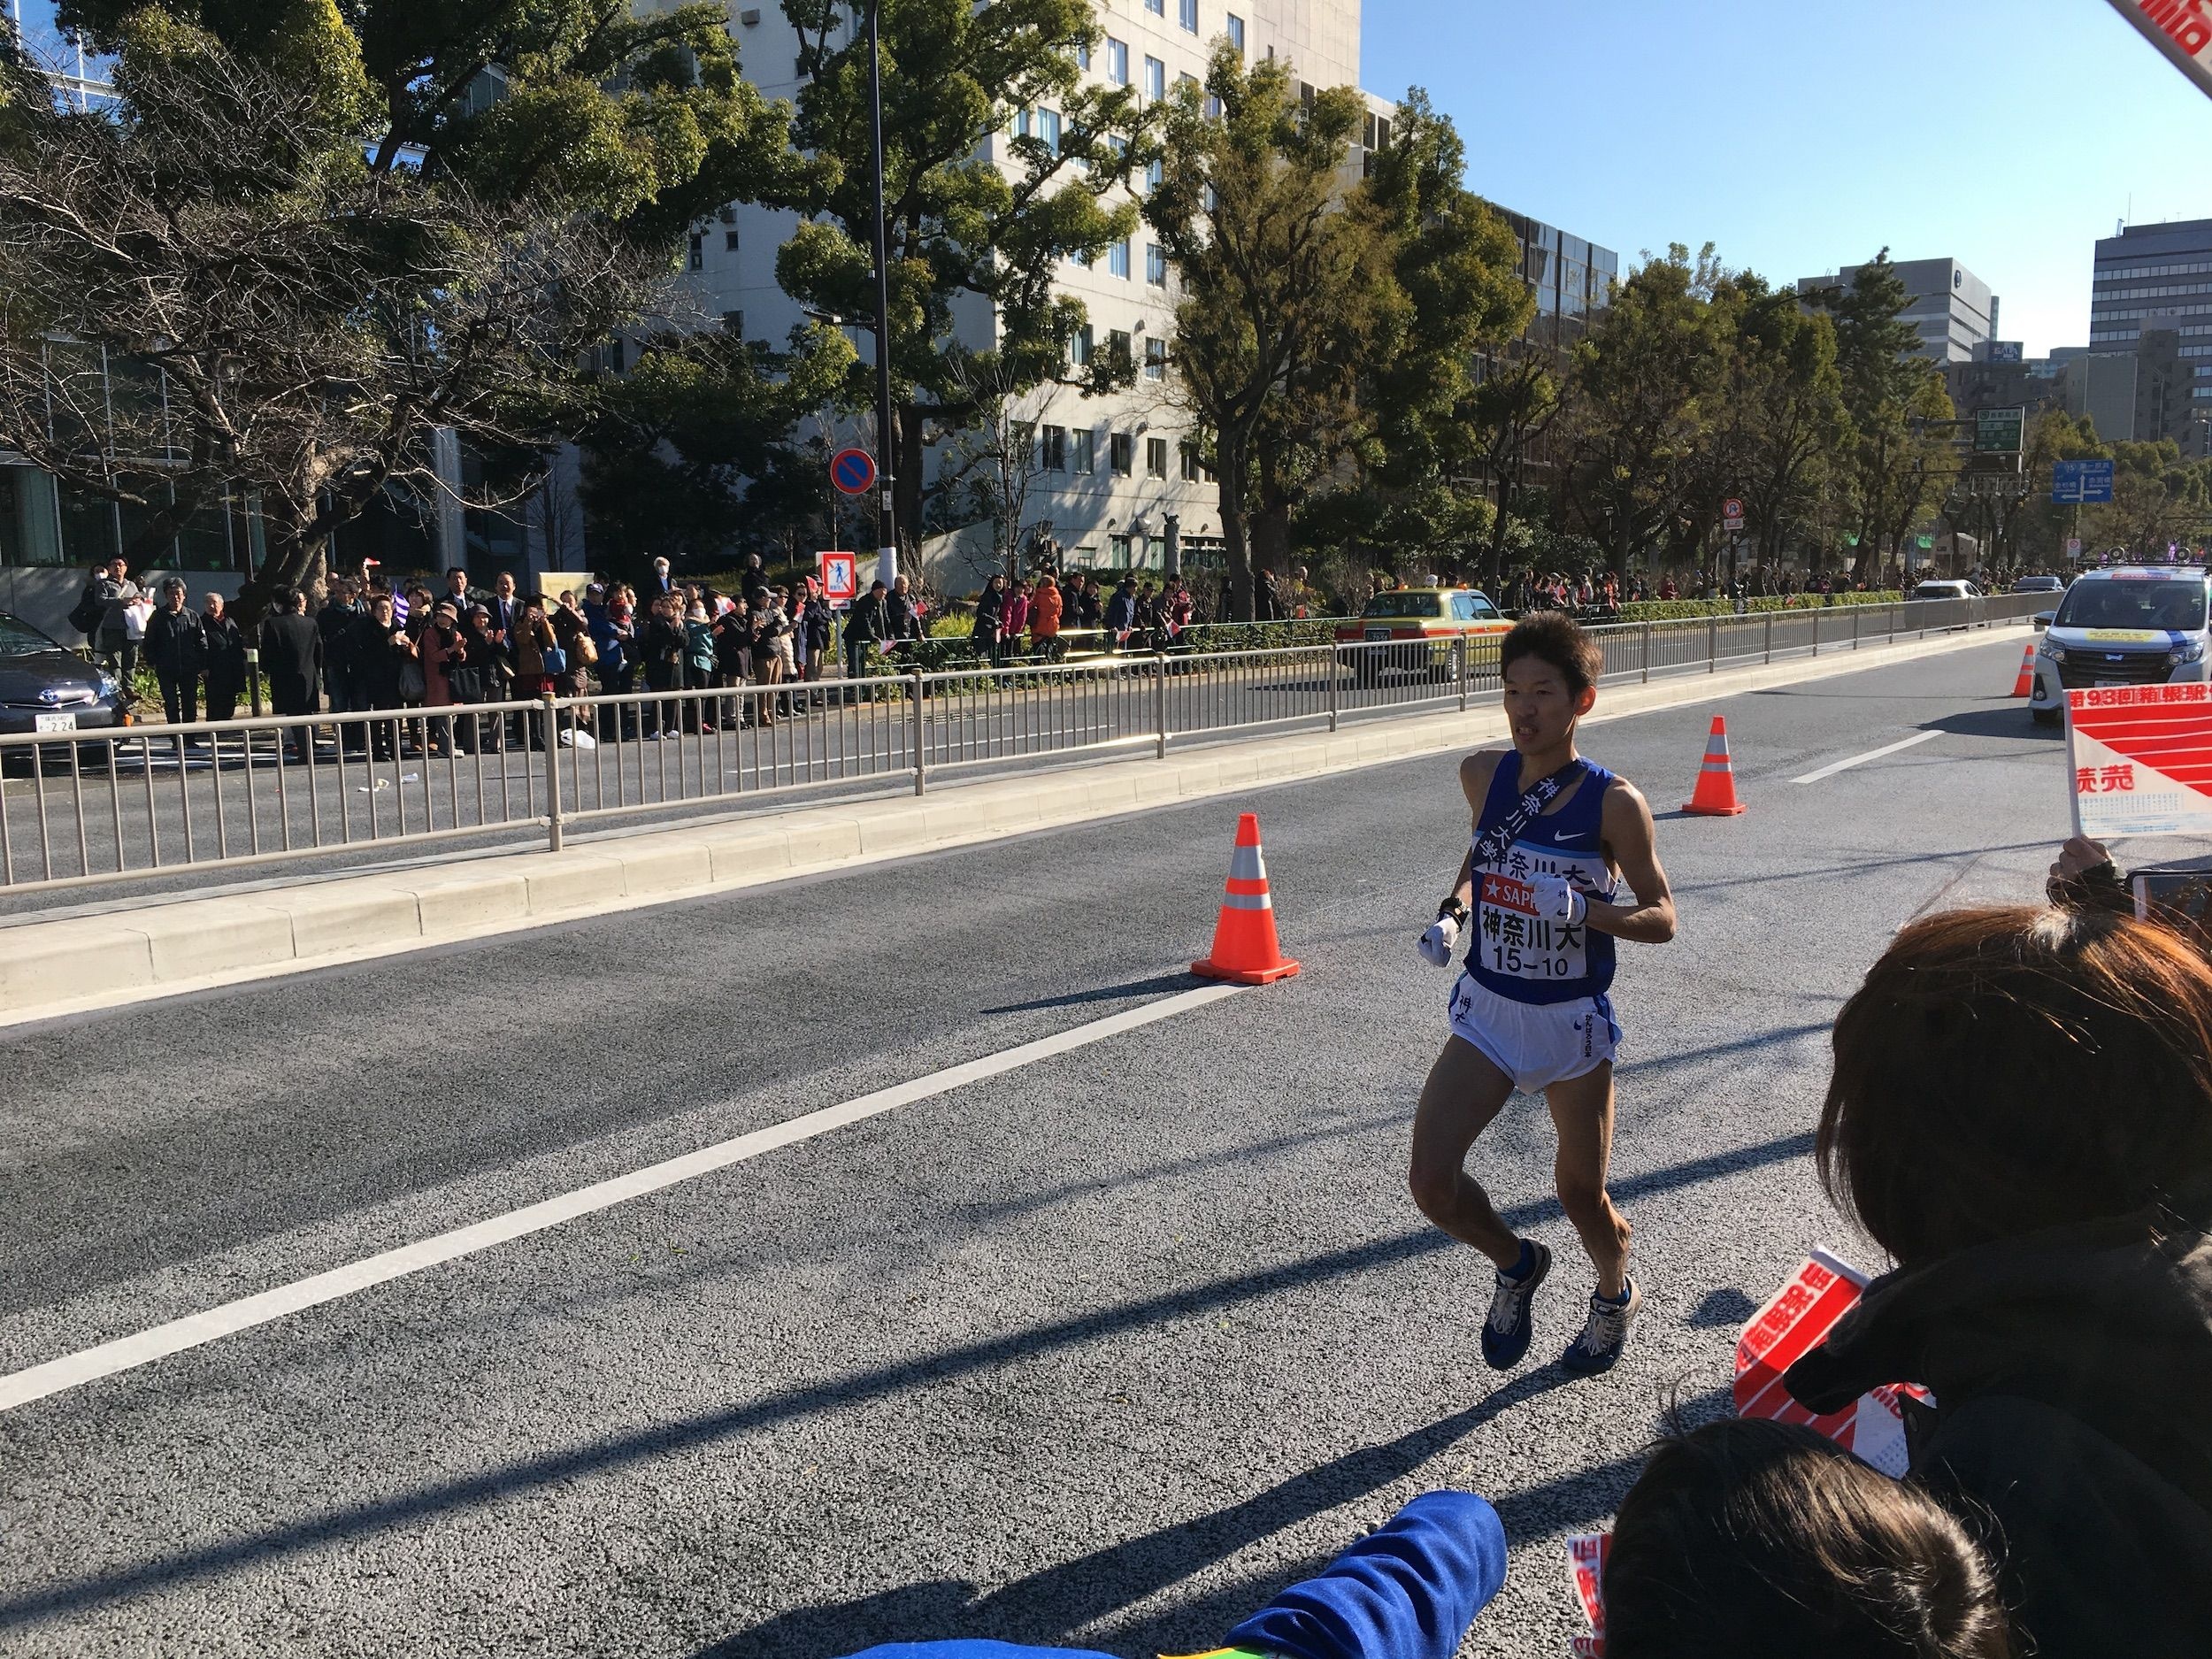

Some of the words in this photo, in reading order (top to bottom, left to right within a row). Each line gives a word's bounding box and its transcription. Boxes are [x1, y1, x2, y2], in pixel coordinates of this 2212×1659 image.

[2070, 684, 2212, 707] 第93回箱根駅
[1479, 778, 1560, 860] 神奈川大学
[1483, 906, 1582, 952] 神奈川大
[1494, 945, 1569, 976] 15-10
